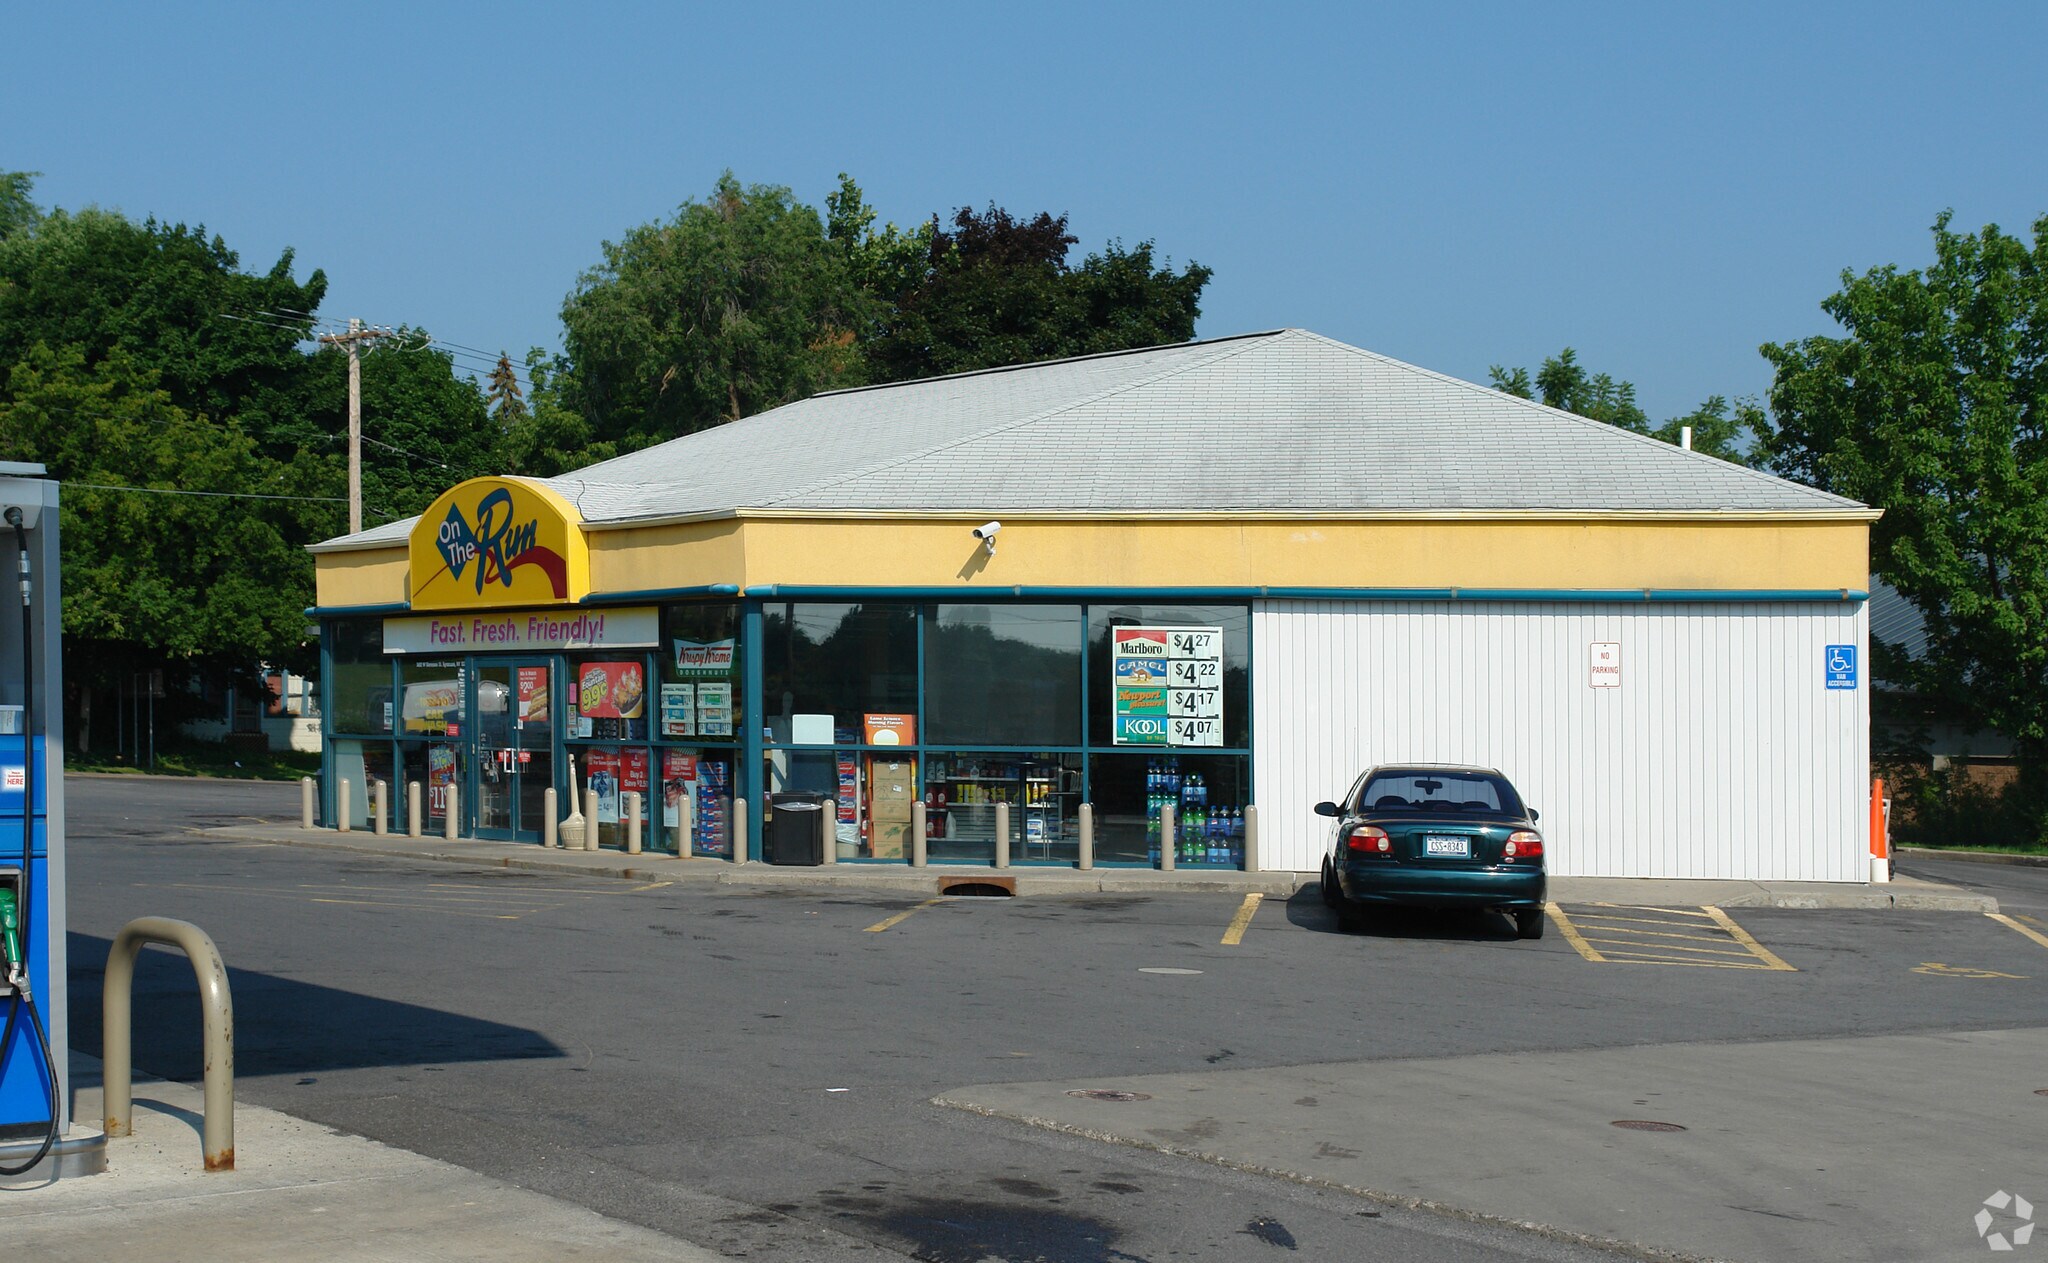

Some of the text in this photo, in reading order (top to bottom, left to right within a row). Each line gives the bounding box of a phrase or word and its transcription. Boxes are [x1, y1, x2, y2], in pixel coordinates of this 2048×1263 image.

[440, 521, 460, 543] On
[475, 487, 538, 596] Run
[448, 542, 475, 566] The
[431, 614, 605, 645] Fast. Fresh. Friendly!
[1120, 643, 1163, 655] Marlboro
[1600, 652, 1610, 660] NO
[1119, 661, 1165, 672] CAMEL
[1592, 666, 1619, 674] PARKING
[1118, 690, 1161, 701] Newport
[1125, 719, 1166, 735] KOOL
